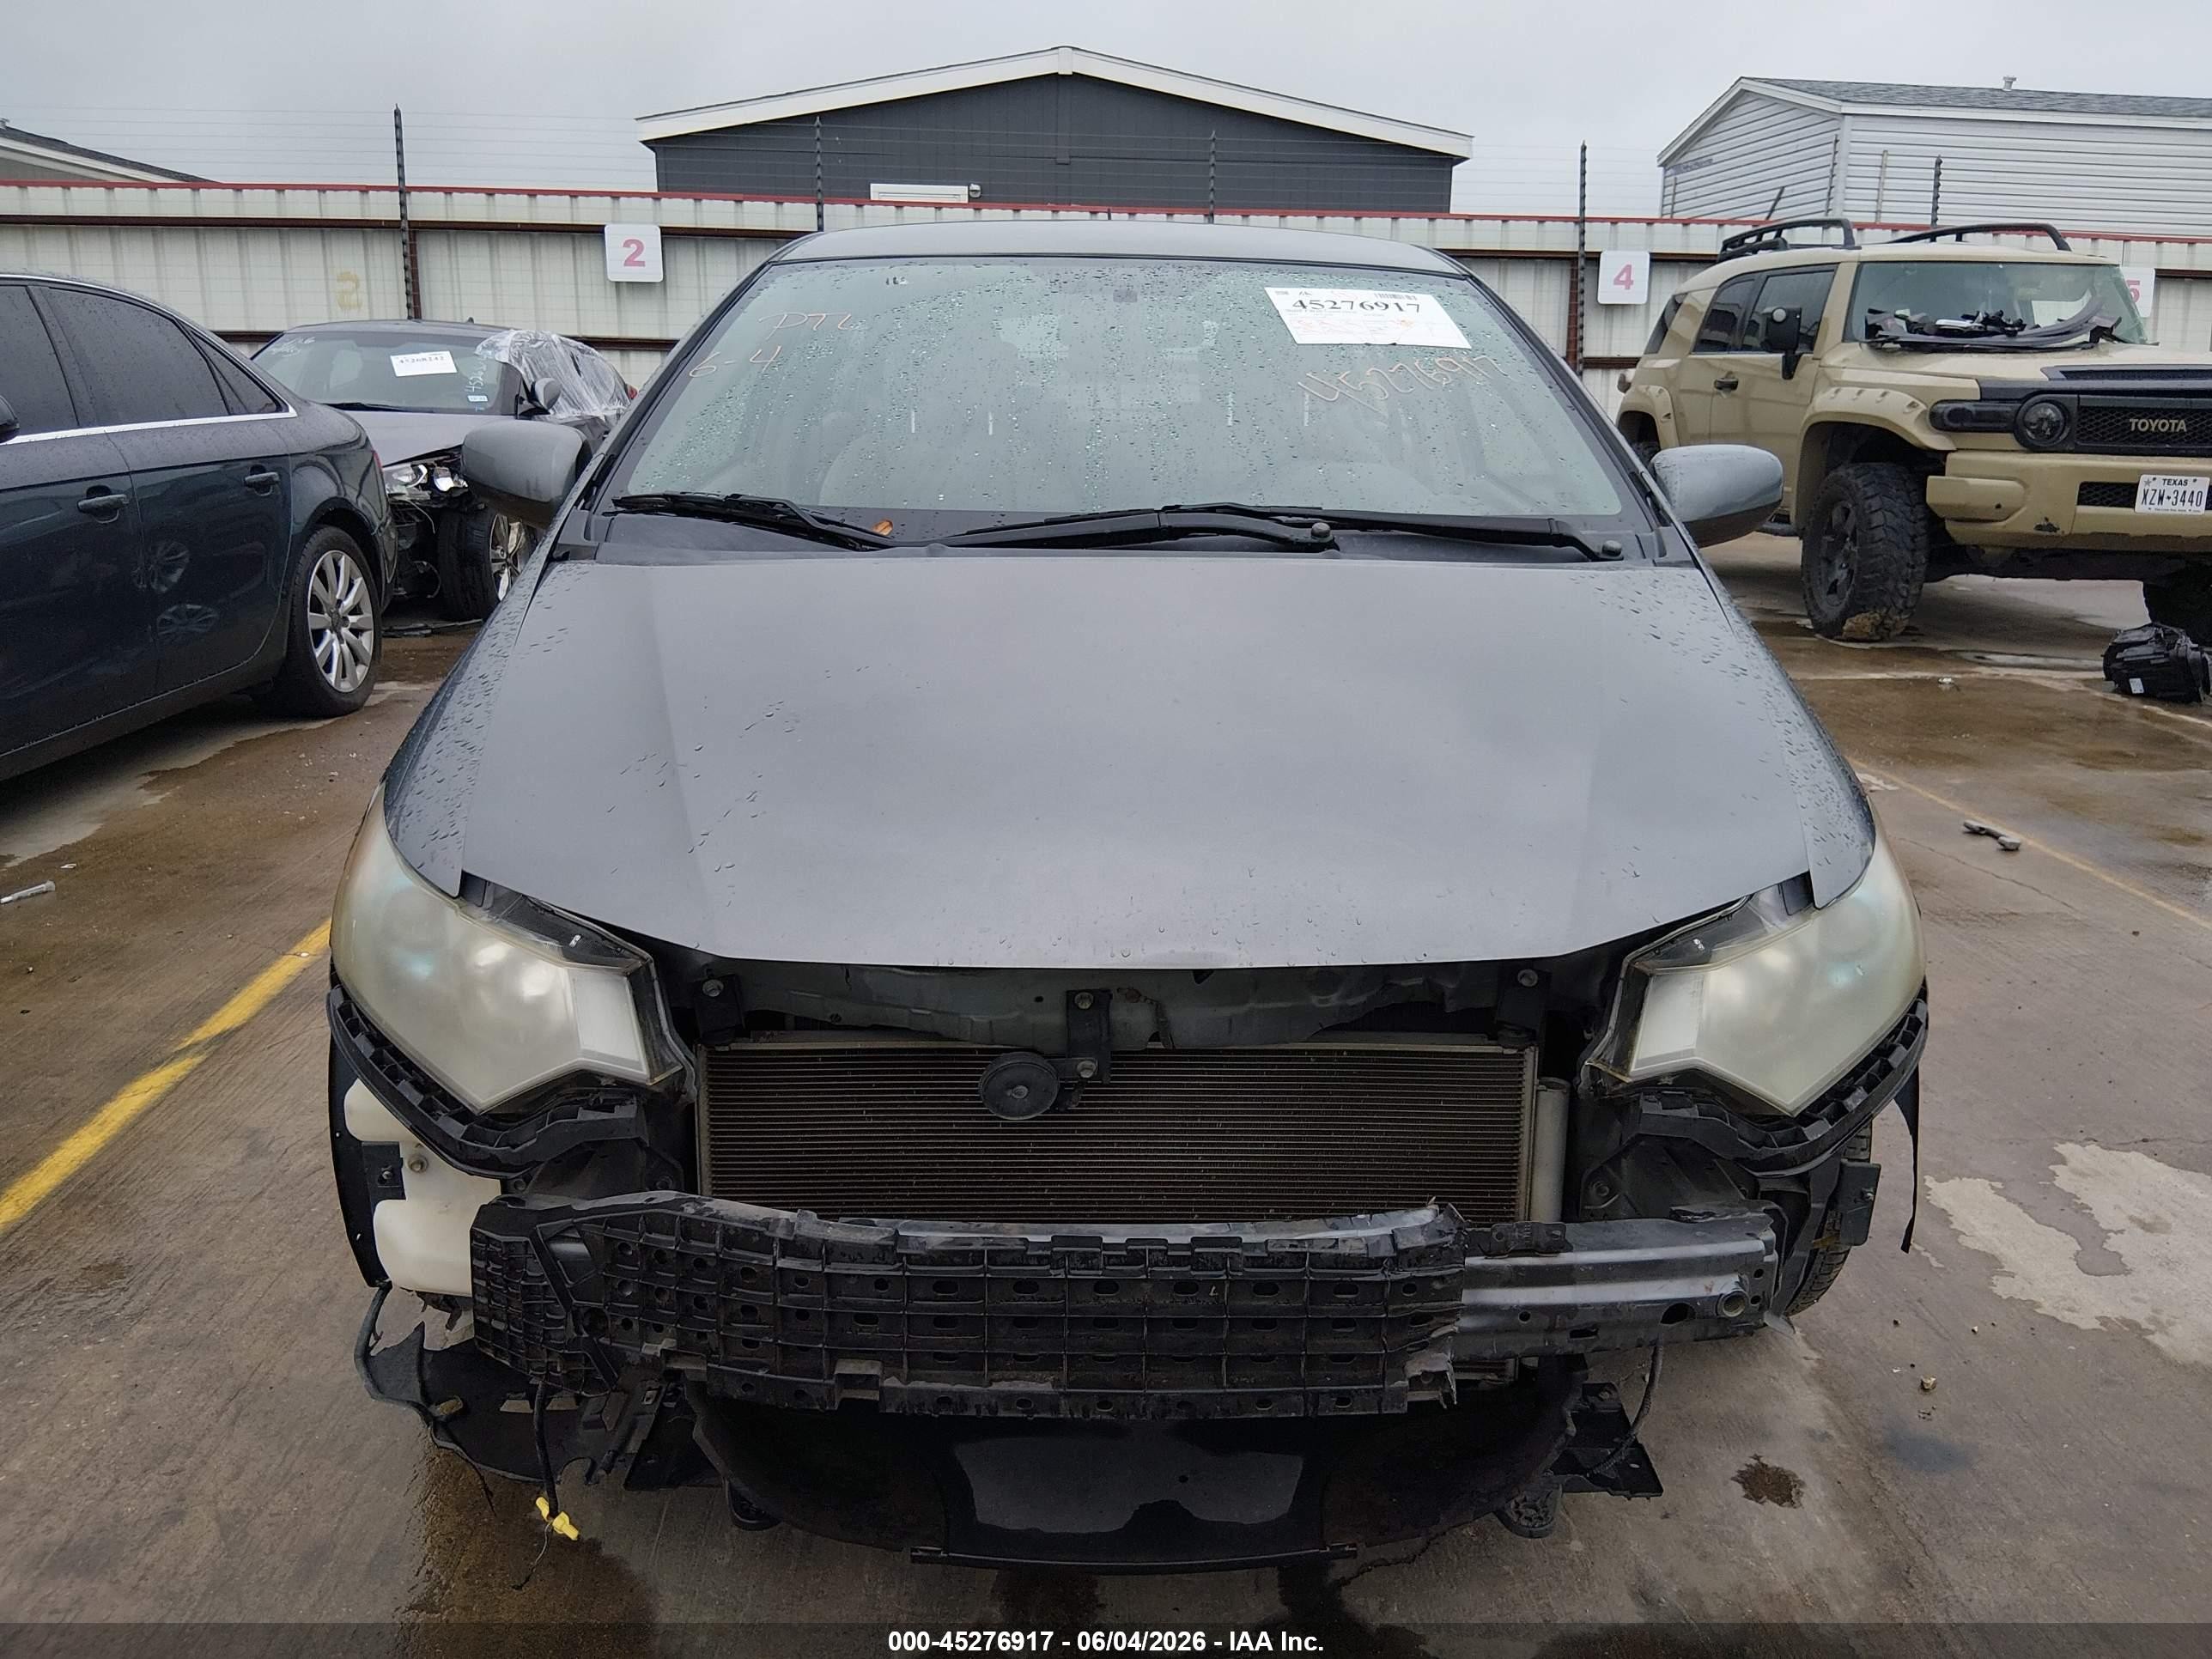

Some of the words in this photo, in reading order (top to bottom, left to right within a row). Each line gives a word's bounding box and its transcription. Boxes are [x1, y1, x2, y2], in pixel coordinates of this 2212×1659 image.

[623, 239, 646, 267] 2
[1613, 264, 1634, 290] 4
[1292, 299, 1421, 313] 45276917
[2130, 418, 2188, 433] TOYOTA
[2162, 477, 2189, 487] TEXAS
